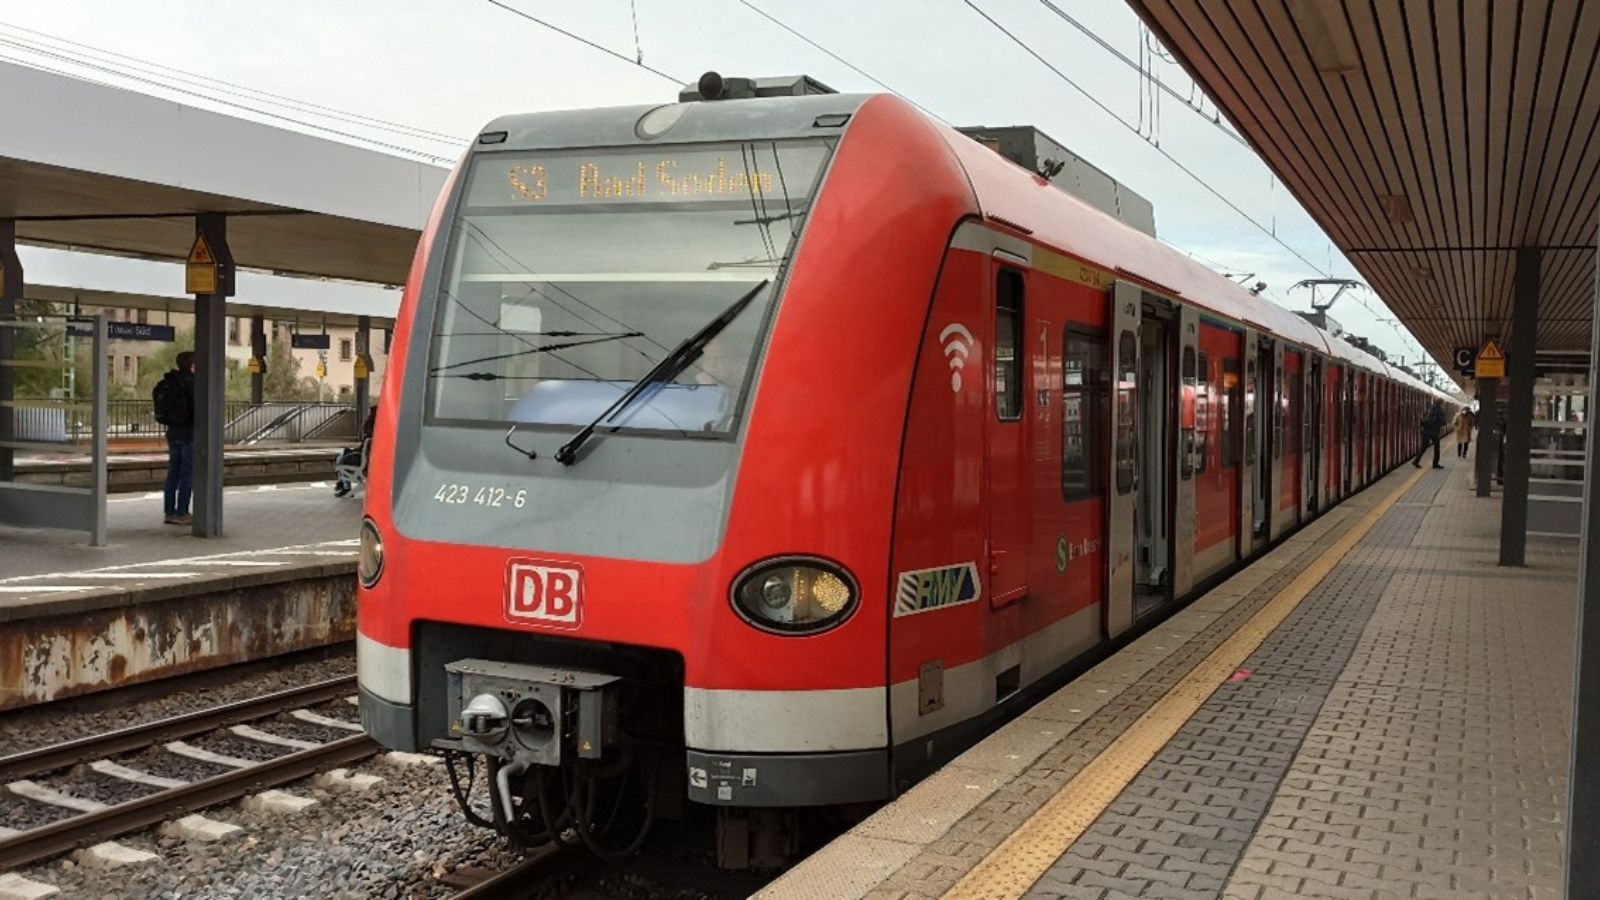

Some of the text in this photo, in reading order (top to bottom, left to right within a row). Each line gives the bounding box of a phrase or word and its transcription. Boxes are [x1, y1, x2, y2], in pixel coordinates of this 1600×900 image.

[1457, 349, 1471, 367] C
[433, 483, 528, 509] 423 412-6
[514, 568, 573, 617] DB
